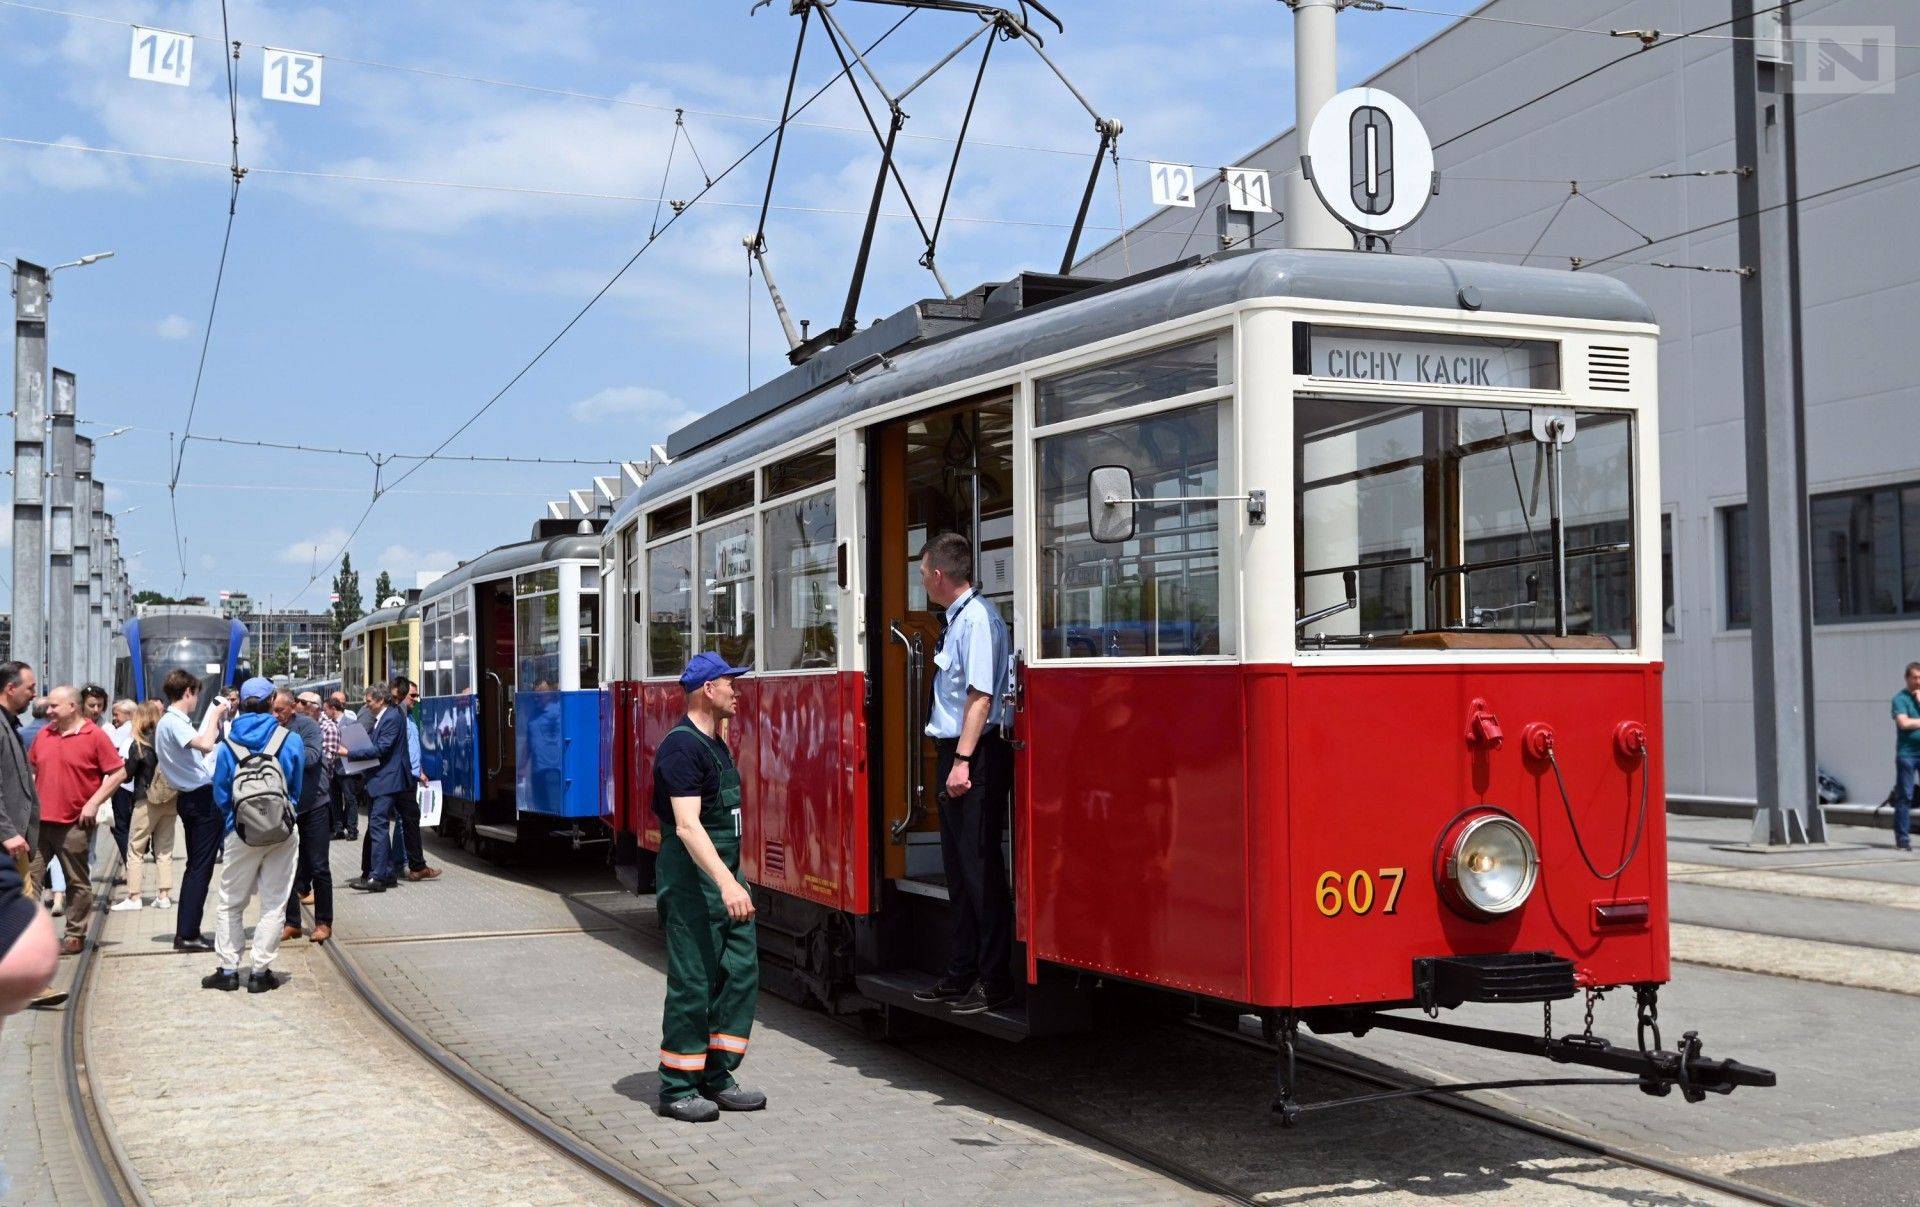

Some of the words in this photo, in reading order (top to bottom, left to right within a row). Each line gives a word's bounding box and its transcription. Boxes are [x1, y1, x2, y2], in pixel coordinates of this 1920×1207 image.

[139, 33, 186, 79] 14
[271, 55, 314, 97] 13
[1349, 105, 1394, 216] 0
[1156, 166, 1189, 202] 12
[1234, 173, 1266, 207] 11
[1328, 349, 1402, 381] CICHY
[1416, 354, 1491, 387] KACIK
[1315, 867, 1406, 918] 607
